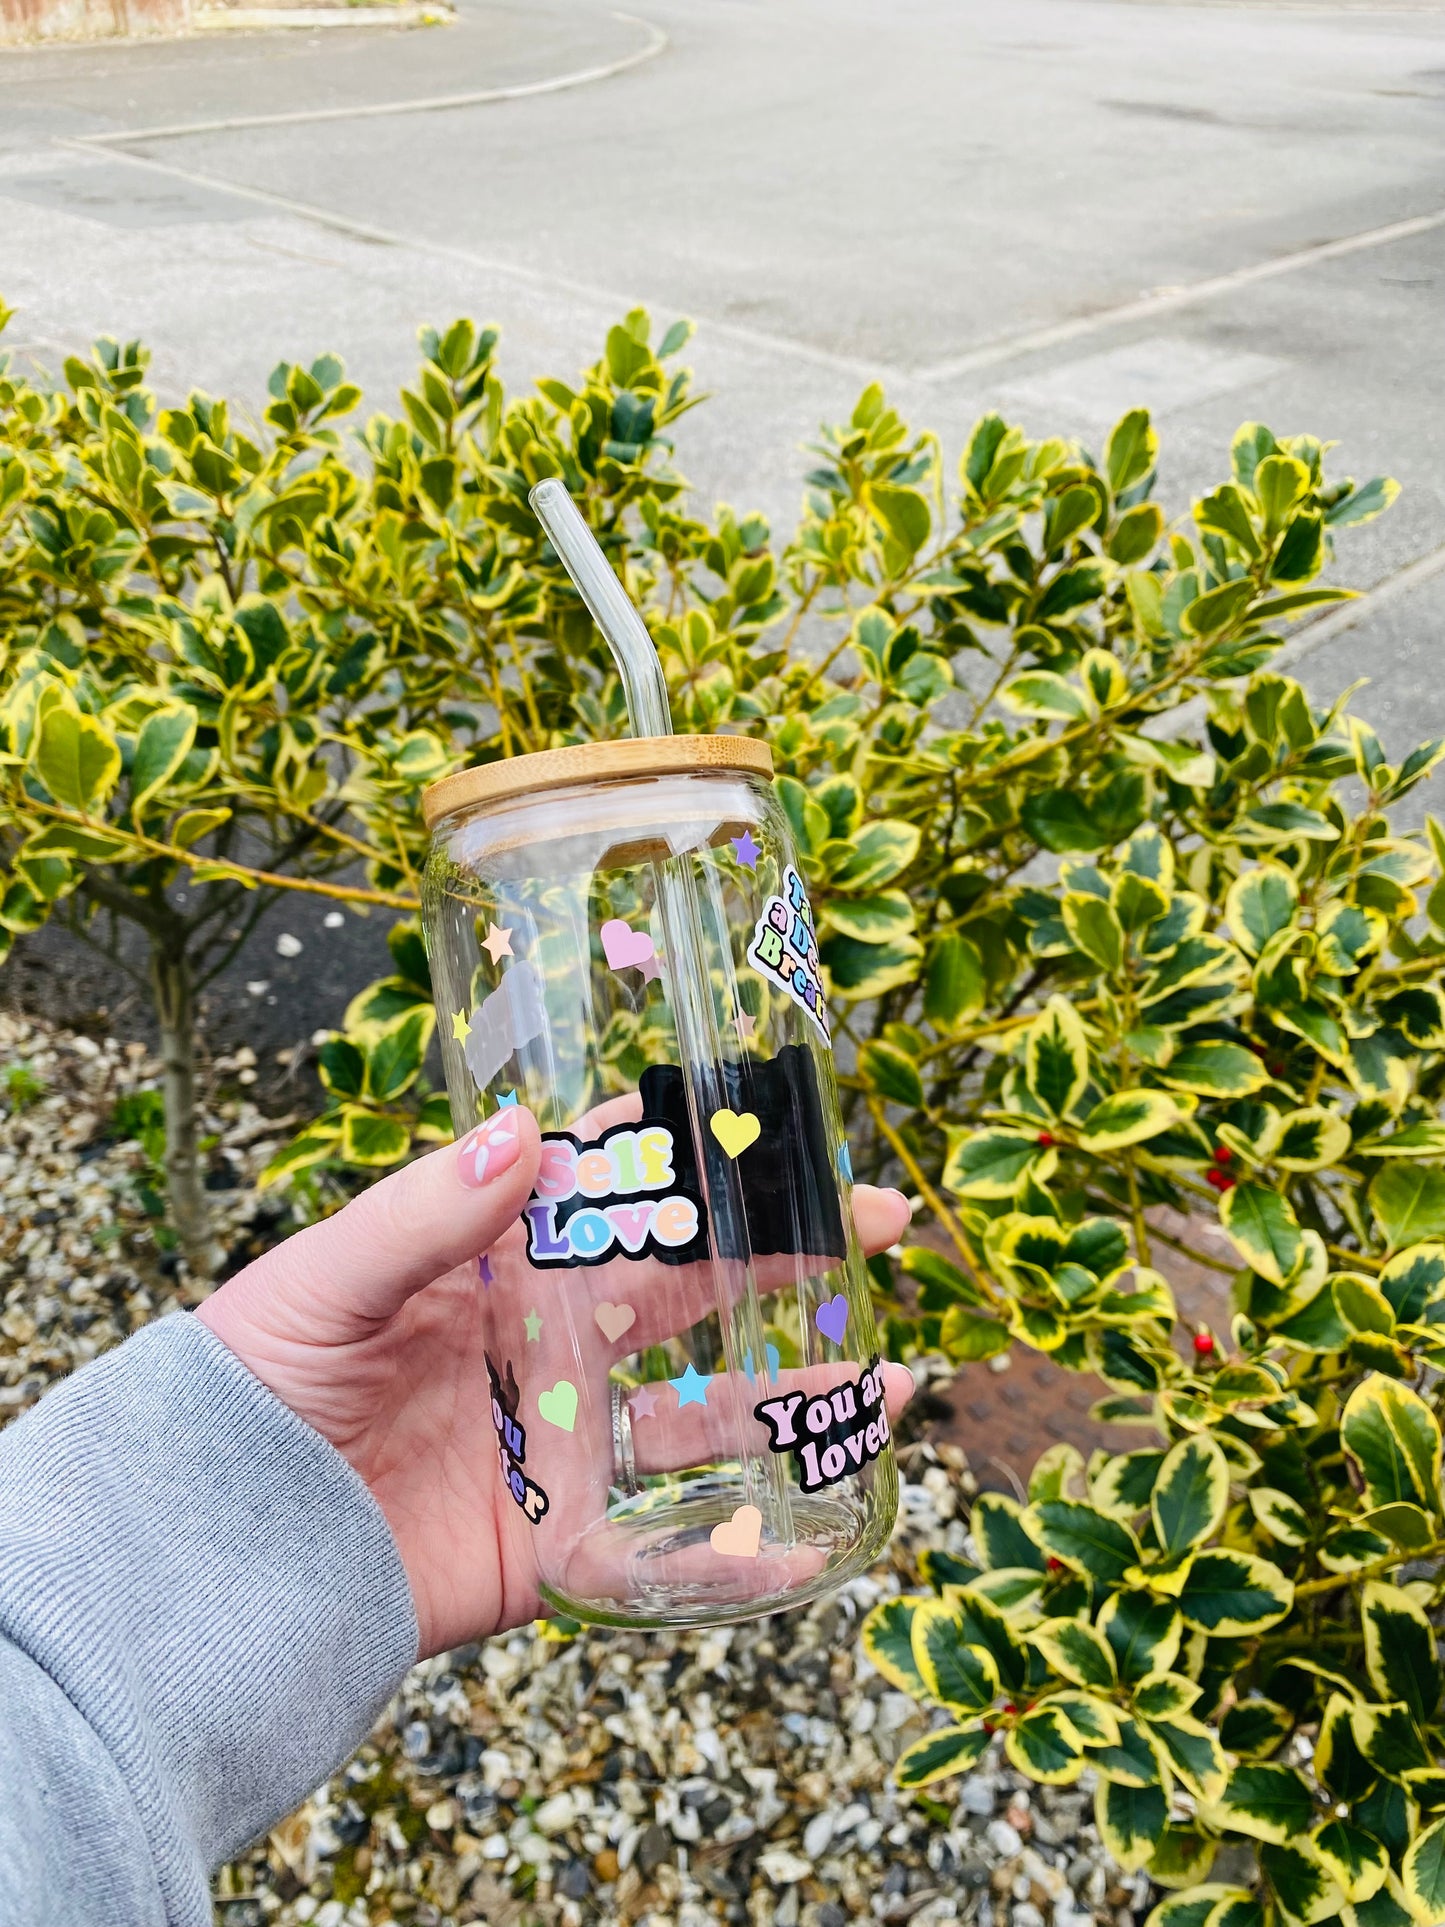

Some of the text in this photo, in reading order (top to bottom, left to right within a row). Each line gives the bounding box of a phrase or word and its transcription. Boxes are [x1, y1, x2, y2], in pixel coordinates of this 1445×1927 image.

[768, 902, 787, 935] a
[537, 1133, 670, 1196] Self
[529, 1203, 693, 1254] Love
[491, 1396, 522, 1458] ou
[762, 1361, 885, 1445] You ar
[801, 1399, 890, 1486] loved
[499, 1446, 545, 1519] ter
